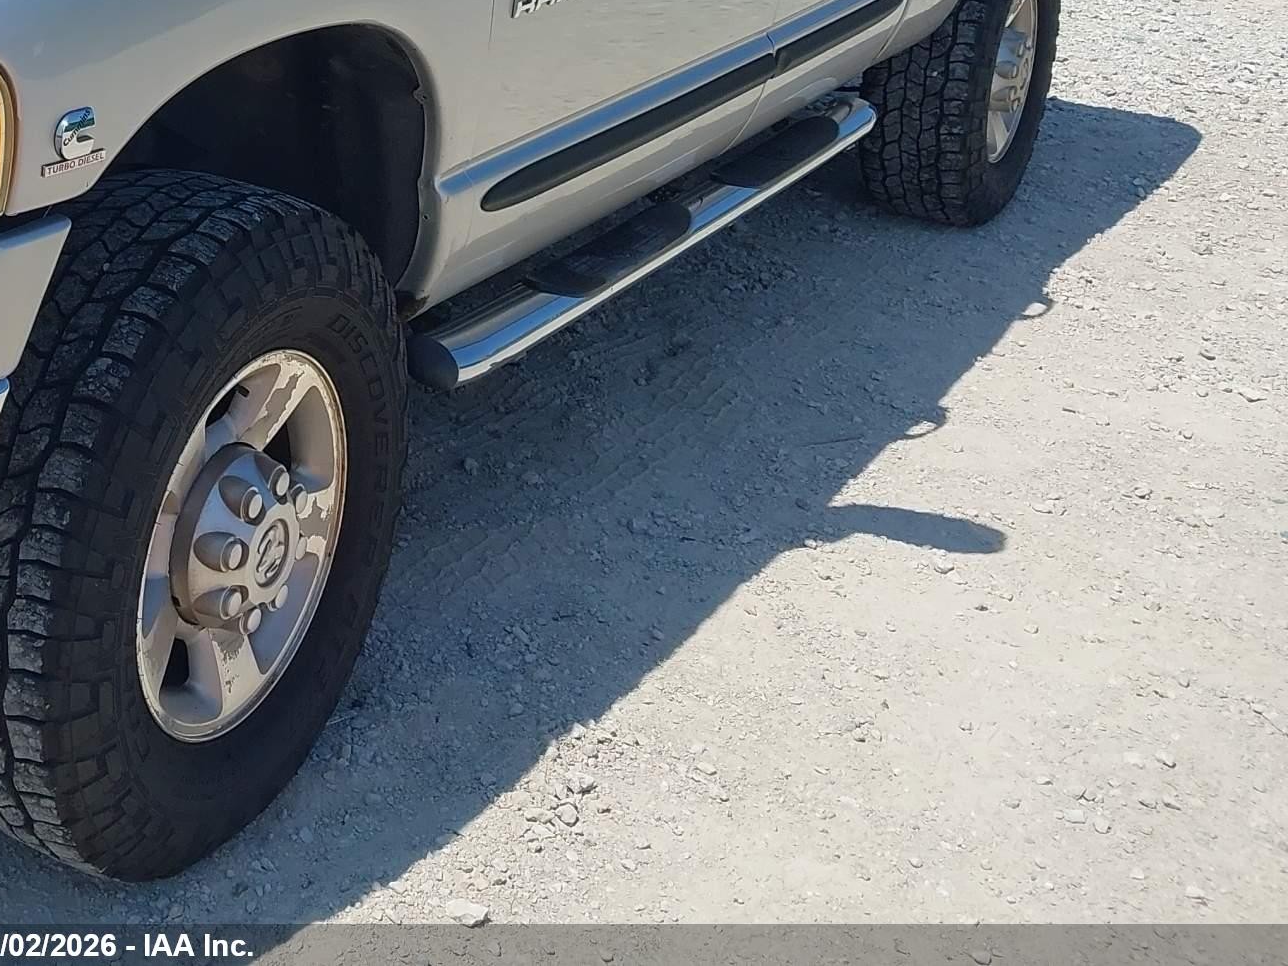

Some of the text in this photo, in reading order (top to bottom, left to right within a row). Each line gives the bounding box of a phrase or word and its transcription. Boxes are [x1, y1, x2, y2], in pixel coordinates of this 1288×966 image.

[63, 109, 91, 147] Cummins
[47, 152, 104, 176] TURBO DIESEL
